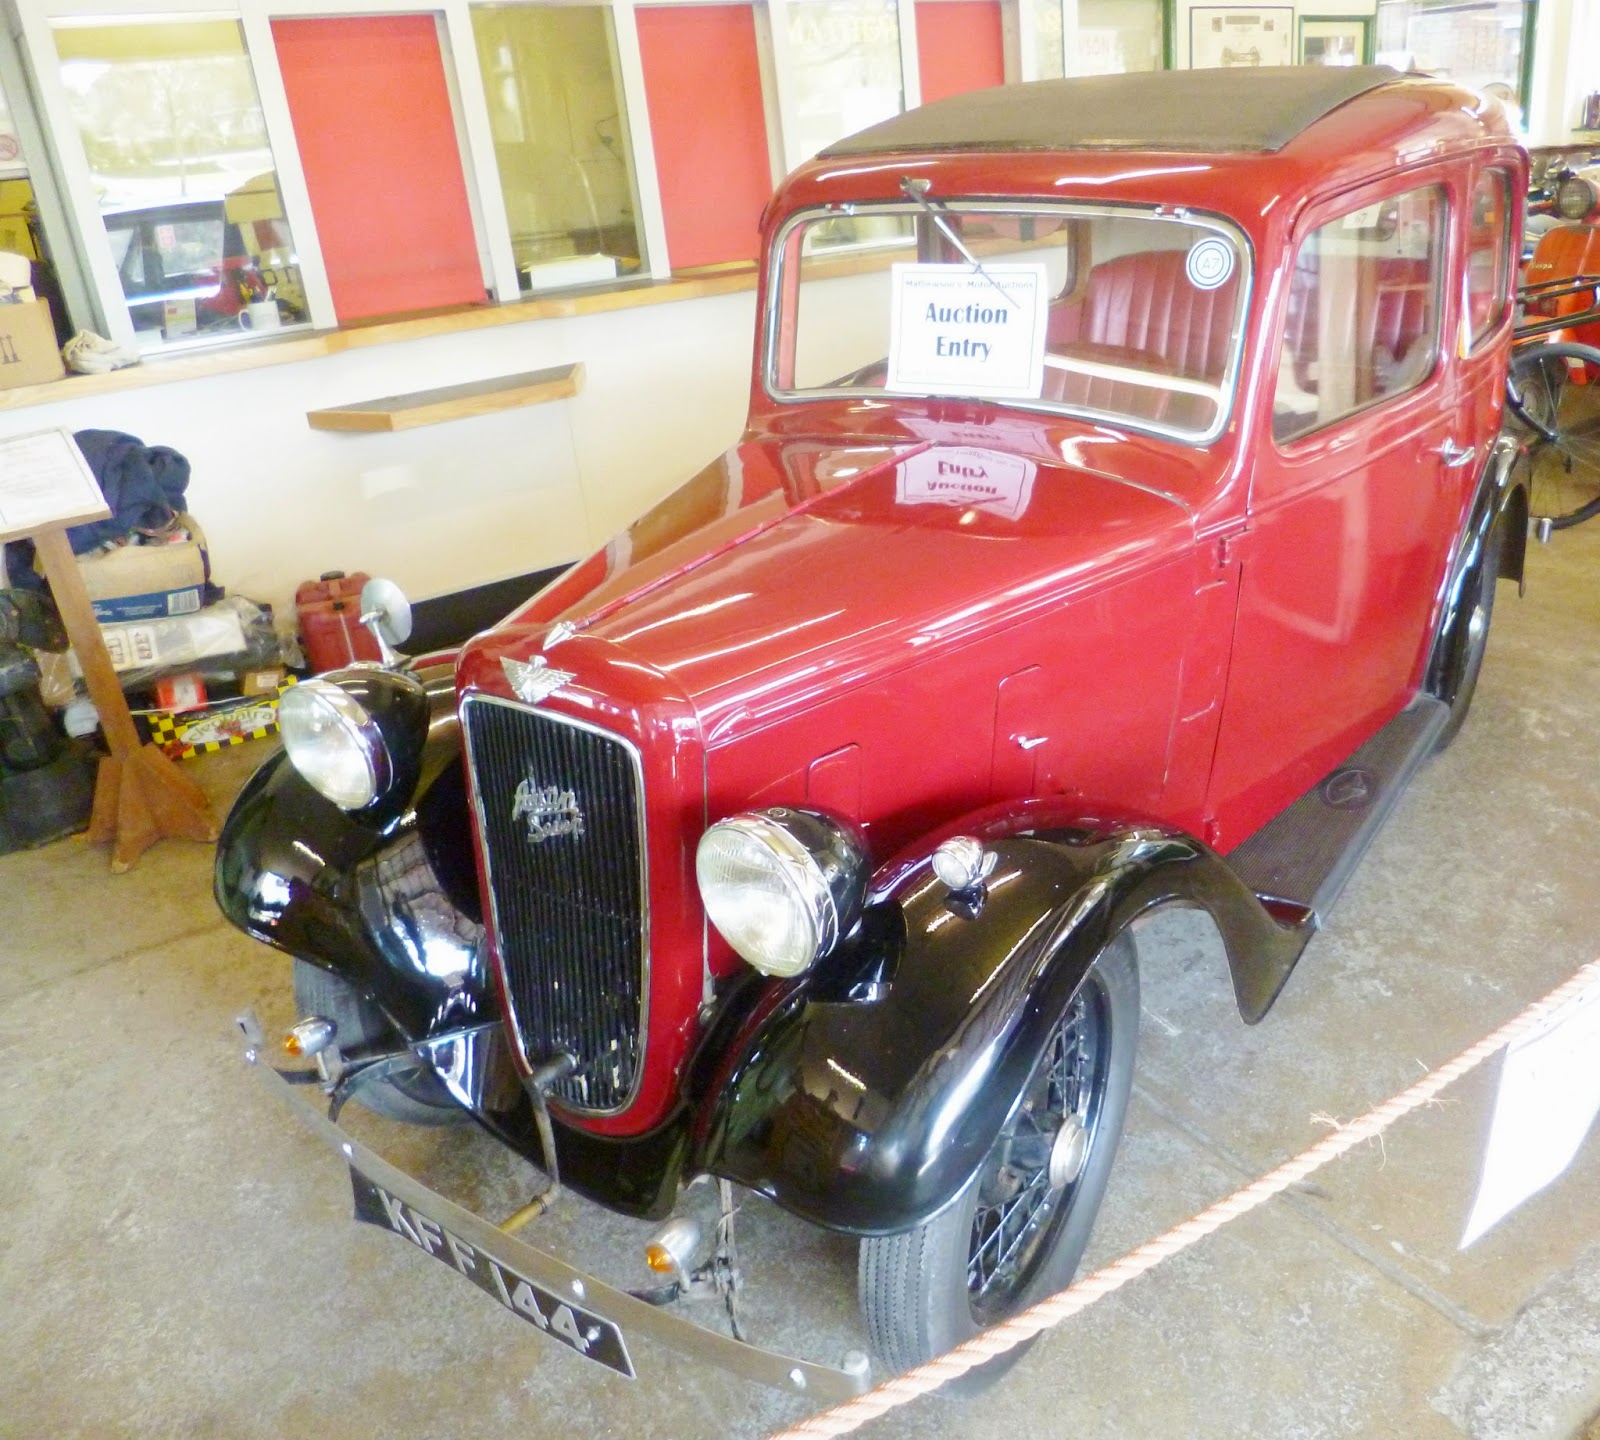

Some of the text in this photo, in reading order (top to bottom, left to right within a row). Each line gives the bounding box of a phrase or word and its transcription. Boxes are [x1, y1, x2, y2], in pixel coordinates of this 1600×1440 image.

[967, 280, 992, 289] Motor
[925, 302, 1008, 325] Auction
[936, 336, 992, 363] Entry
